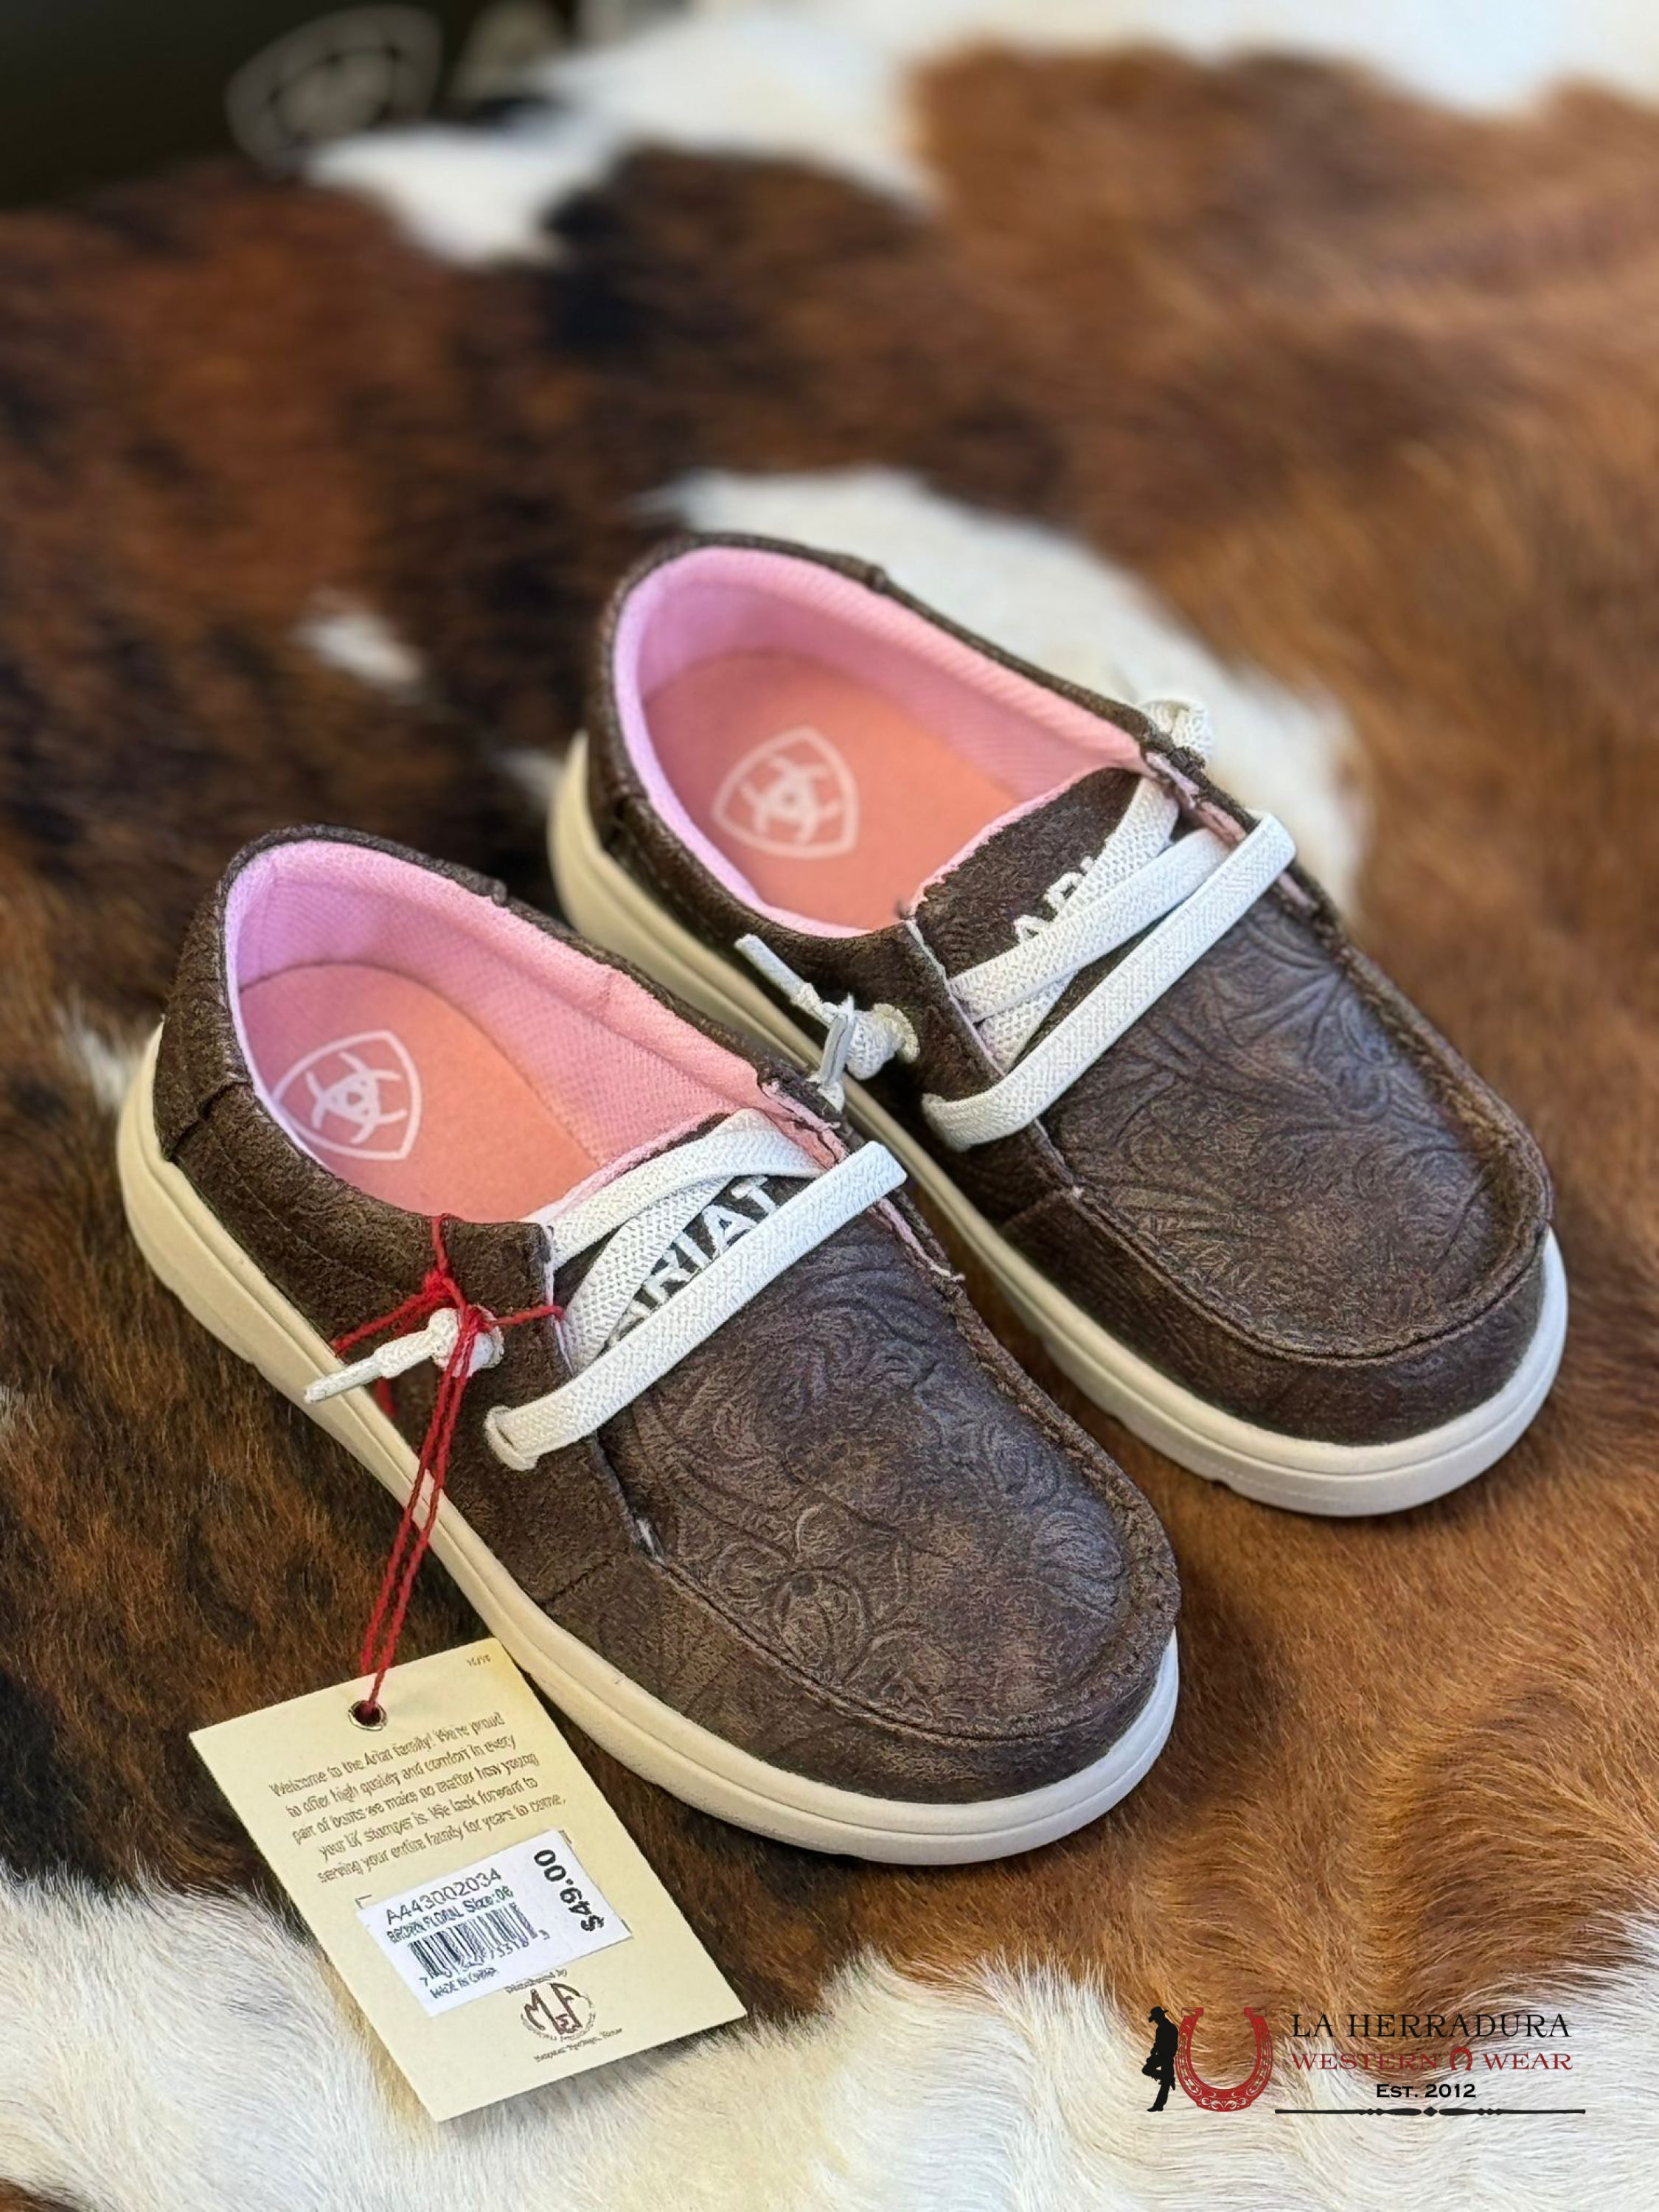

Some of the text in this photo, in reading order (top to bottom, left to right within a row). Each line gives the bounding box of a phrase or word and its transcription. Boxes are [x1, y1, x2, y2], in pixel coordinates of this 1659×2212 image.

[268, 1772, 328, 1797] Welcome
[327, 1767, 343, 1778] to
[341, 1760, 366, 1773] the
[364, 1749, 393, 1766] Ariat
[470, 1712, 505, 1736] proud
[285, 1734, 516, 1818] to offer high quality and comfort in every
[292, 1825, 316, 1846] pair
[317, 1817, 331, 1833] of
[365, 1803, 385, 1816] we
[383, 1790, 418, 1810] make
[419, 1785, 436, 1798] no
[474, 1764, 501, 1780] how
[500, 1753, 540, 1775] young
[319, 1840, 346, 1864] your
[448, 1793, 480, 1812] look
[478, 1780, 525, 1804] forward
[523, 1778, 538, 1789] to
[318, 1860, 364, 1883] serving
[361, 1850, 389, 1873] your
[391, 1839, 426, 1858] entire
[424, 1825, 464, 1846] family
[463, 1819, 482, 1833] for
[481, 1808, 517, 1832] years
[513, 1804, 529, 1817] to
[386, 1868, 501, 1925] A443002034
[535, 1849, 604, 1932] $49.00
